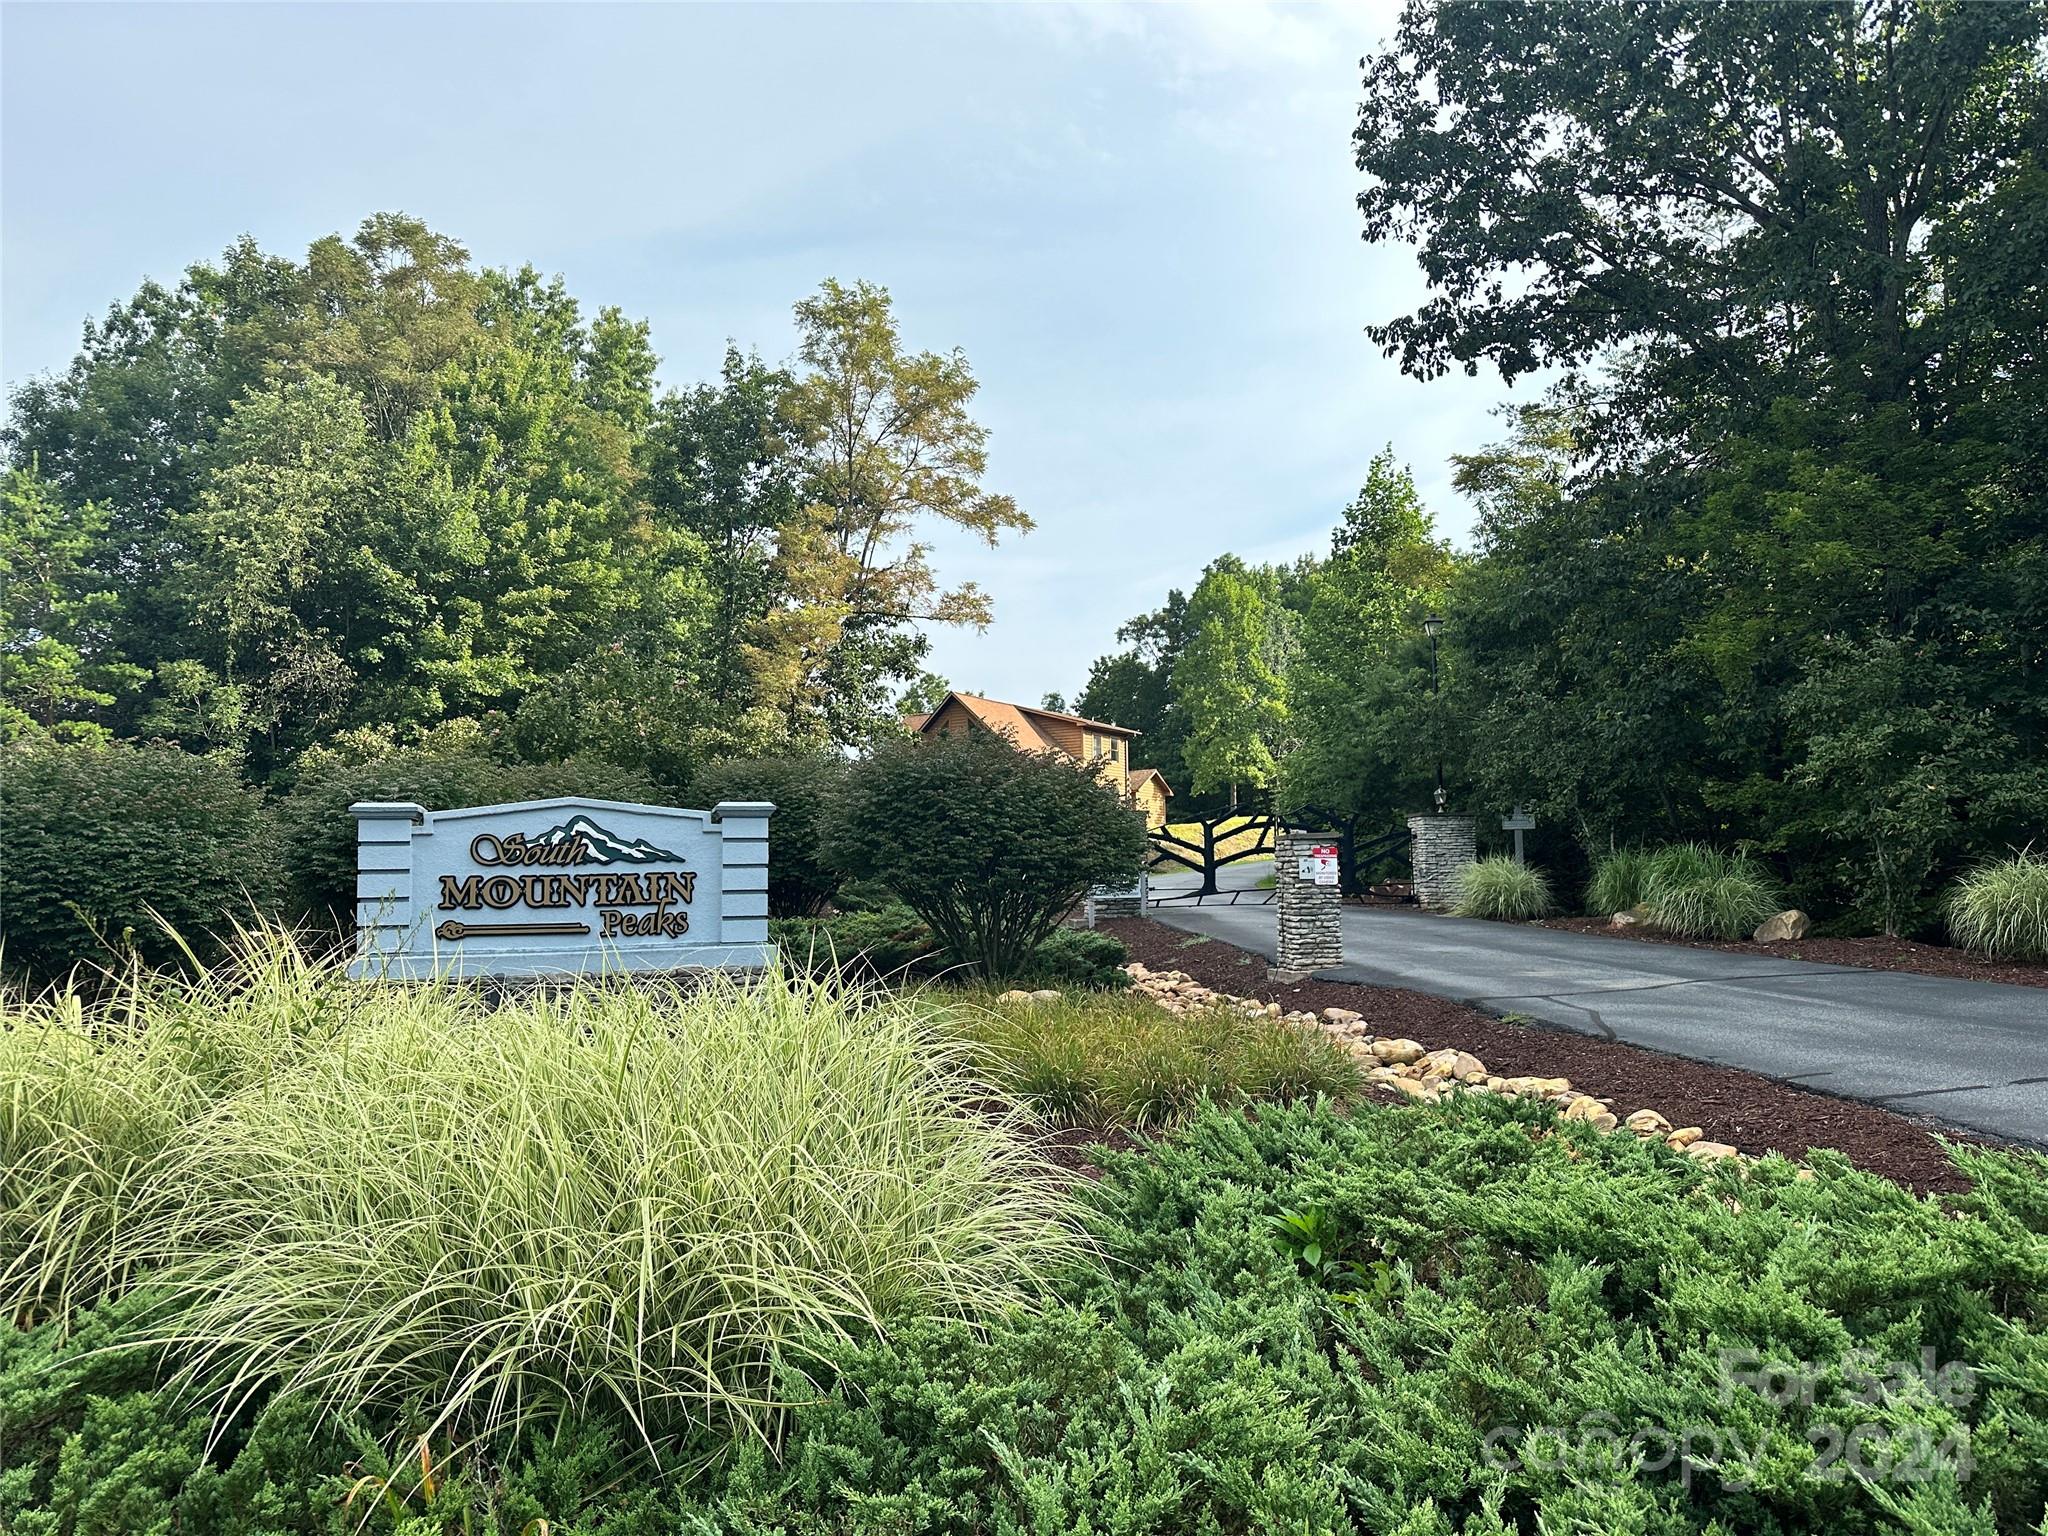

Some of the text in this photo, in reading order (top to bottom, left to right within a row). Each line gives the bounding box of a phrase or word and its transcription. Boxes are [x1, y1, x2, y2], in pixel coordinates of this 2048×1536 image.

[470, 832, 590, 867] South
[438, 872, 698, 910] MOUNTAIN
[599, 897, 690, 939] Peaks
